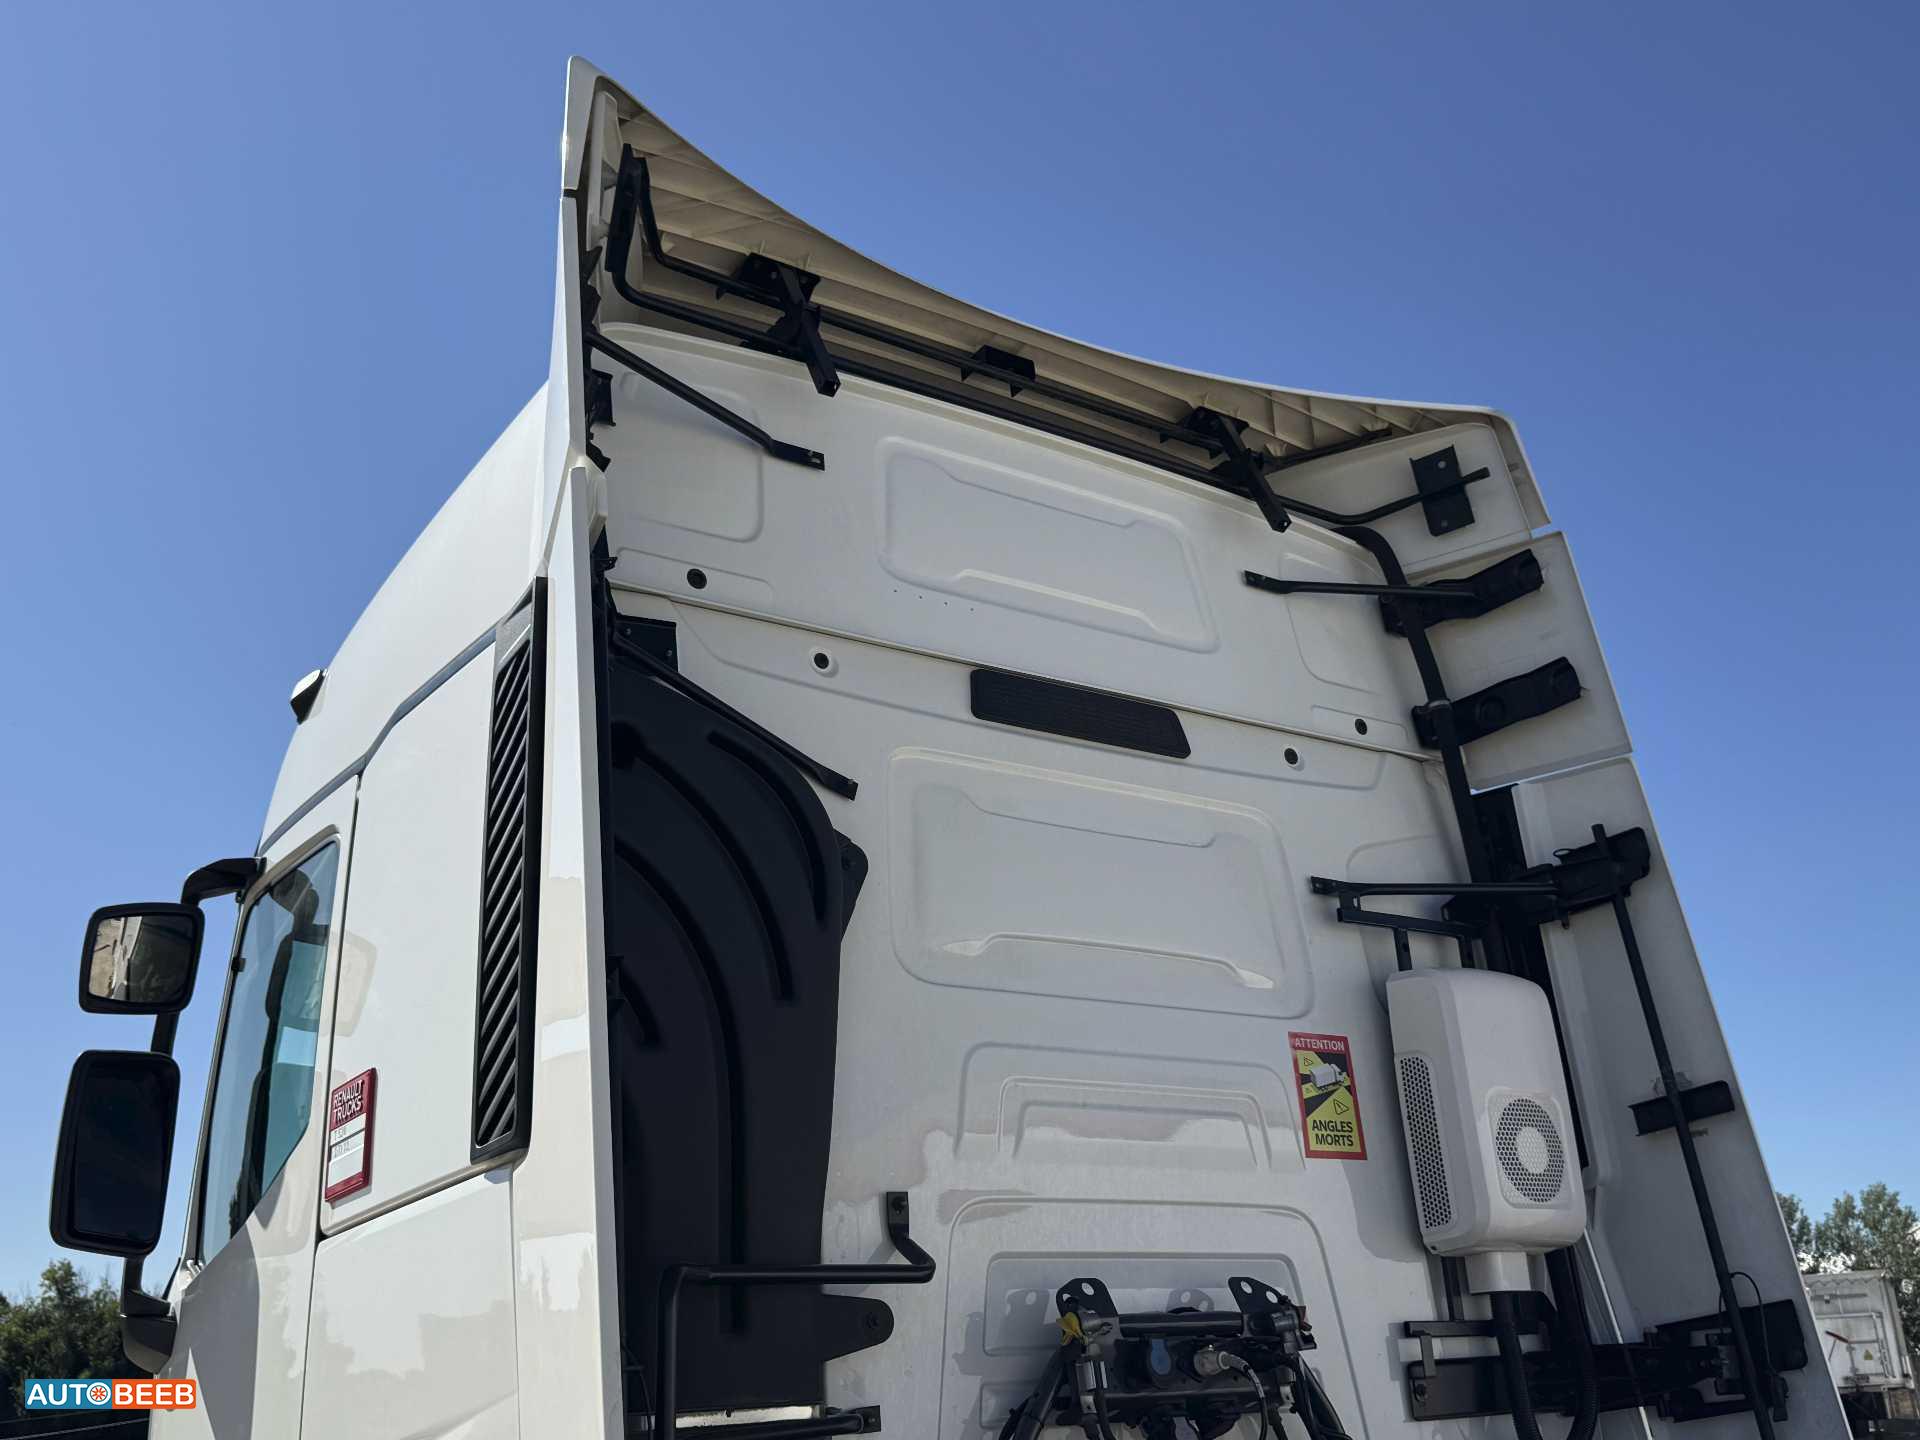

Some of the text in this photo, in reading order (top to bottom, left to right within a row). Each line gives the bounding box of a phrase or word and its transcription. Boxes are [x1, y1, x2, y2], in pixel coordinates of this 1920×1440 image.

[1295, 1038, 1345, 1051] ATTENTION
[333, 1080, 364, 1108] RENAULT
[333, 1096, 363, 1122] TRUCKS
[1312, 1119, 1353, 1133] ANGLES
[1315, 1134, 1354, 1147] MORTS
